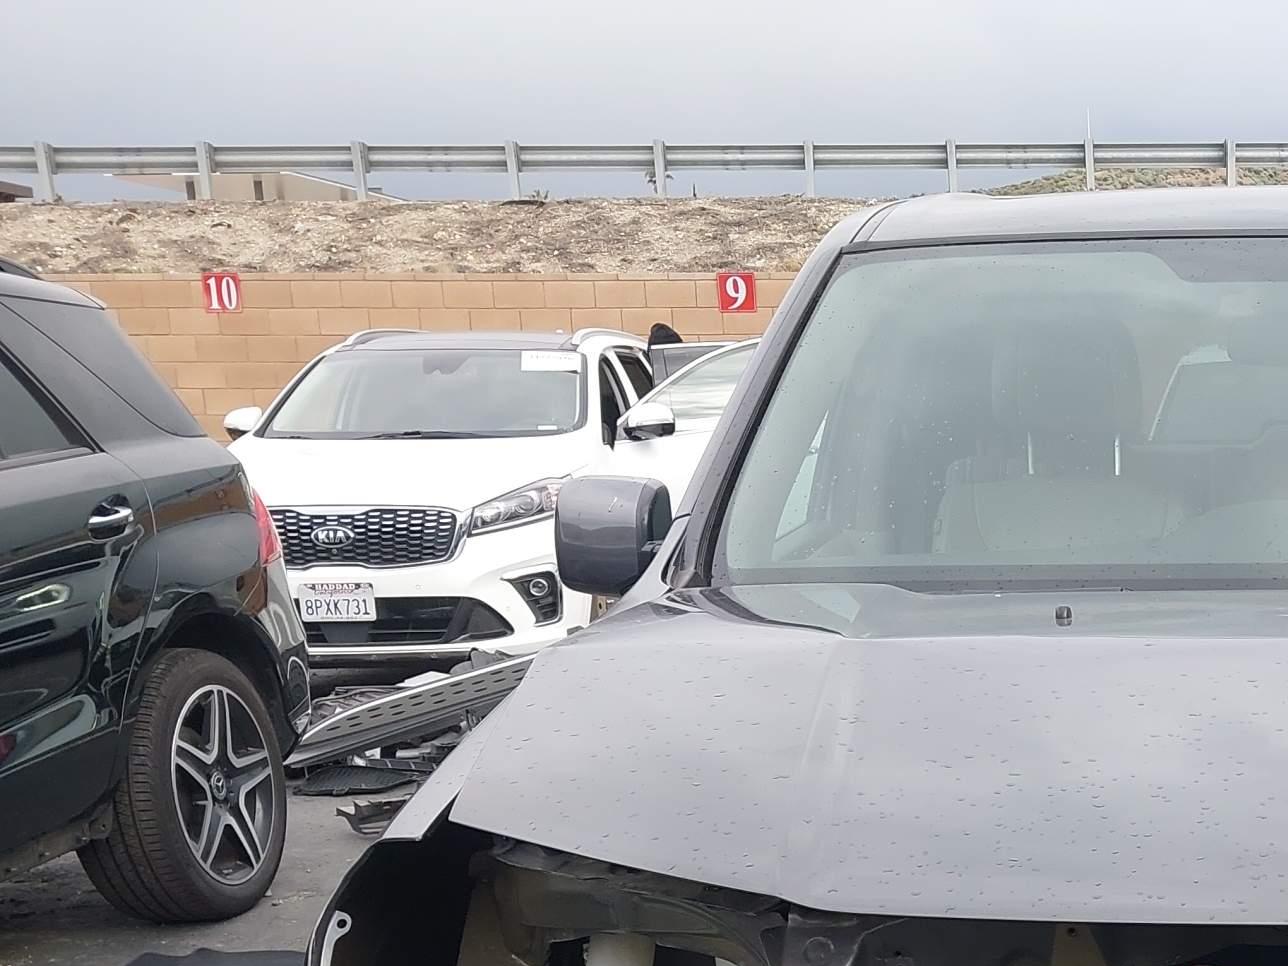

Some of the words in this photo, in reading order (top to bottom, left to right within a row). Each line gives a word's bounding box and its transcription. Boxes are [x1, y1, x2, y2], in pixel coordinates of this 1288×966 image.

[206, 276, 238, 310] 10
[725, 275, 747, 310] 9
[317, 530, 347, 543] KIA
[305, 599, 371, 616] 8PXK731
